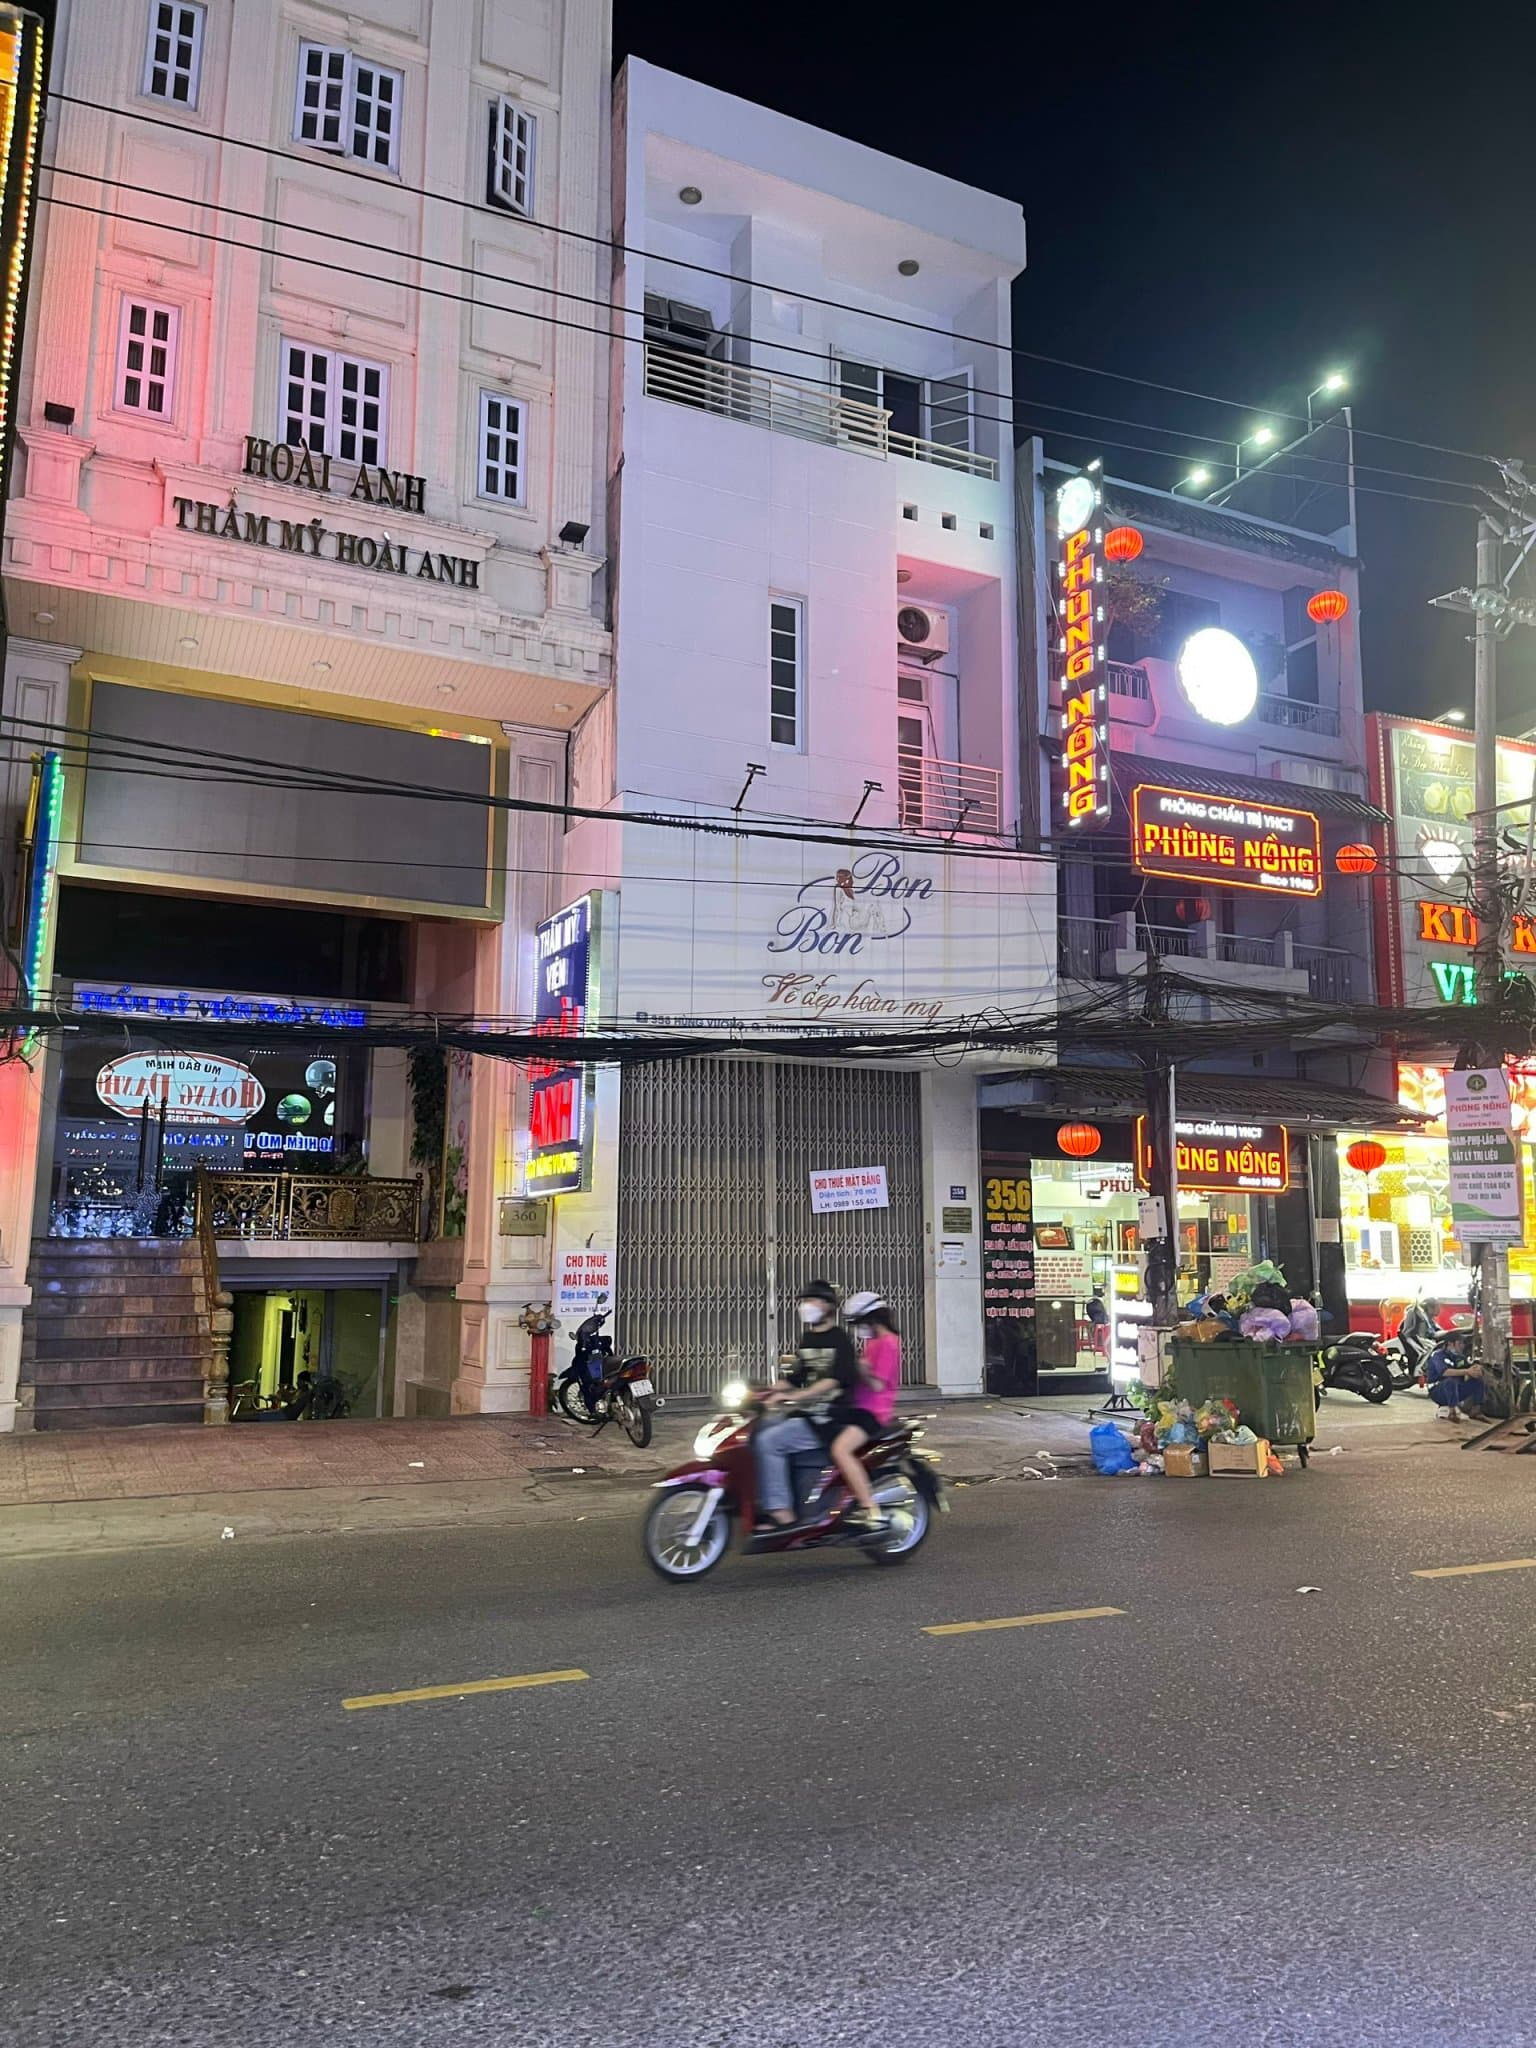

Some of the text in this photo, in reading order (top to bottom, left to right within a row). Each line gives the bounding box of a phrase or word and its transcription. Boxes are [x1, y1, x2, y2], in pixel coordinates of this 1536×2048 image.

[243, 435, 427, 514] HOÀI ANH
[173, 487, 480, 588] THẨM MỸ HOÀI ANH
[1064, 530, 1096, 681] PHÙNG
[1160, 797, 1206, 818] PHÒNG
[1245, 811, 1262, 828] TRỊ
[1264, 816, 1294, 832] YHCT
[1144, 822, 1315, 875] PHÙNG NỒNG
[852, 851, 934, 900] Bon
[1260, 873, 1288, 886] Since
[767, 906, 864, 955] Bon
[1418, 901, 1478, 945] KI
[843, 979, 898, 1013] hoàn
[319, 1004, 366, 1027] ANH
[530, 1078, 579, 1148] ANH
[1176, 1141, 1281, 1174] ÙNG NỒNG
[815, 1178, 827, 1189] CHO
[862, 1172, 881, 1185] BẰNG
[986, 1179, 1031, 1211] 356
[511, 1210, 537, 1222] 360
[566, 1253, 608, 1267] CHO THUÊ
[563, 1269, 608, 1288] MẶT BẰNG
